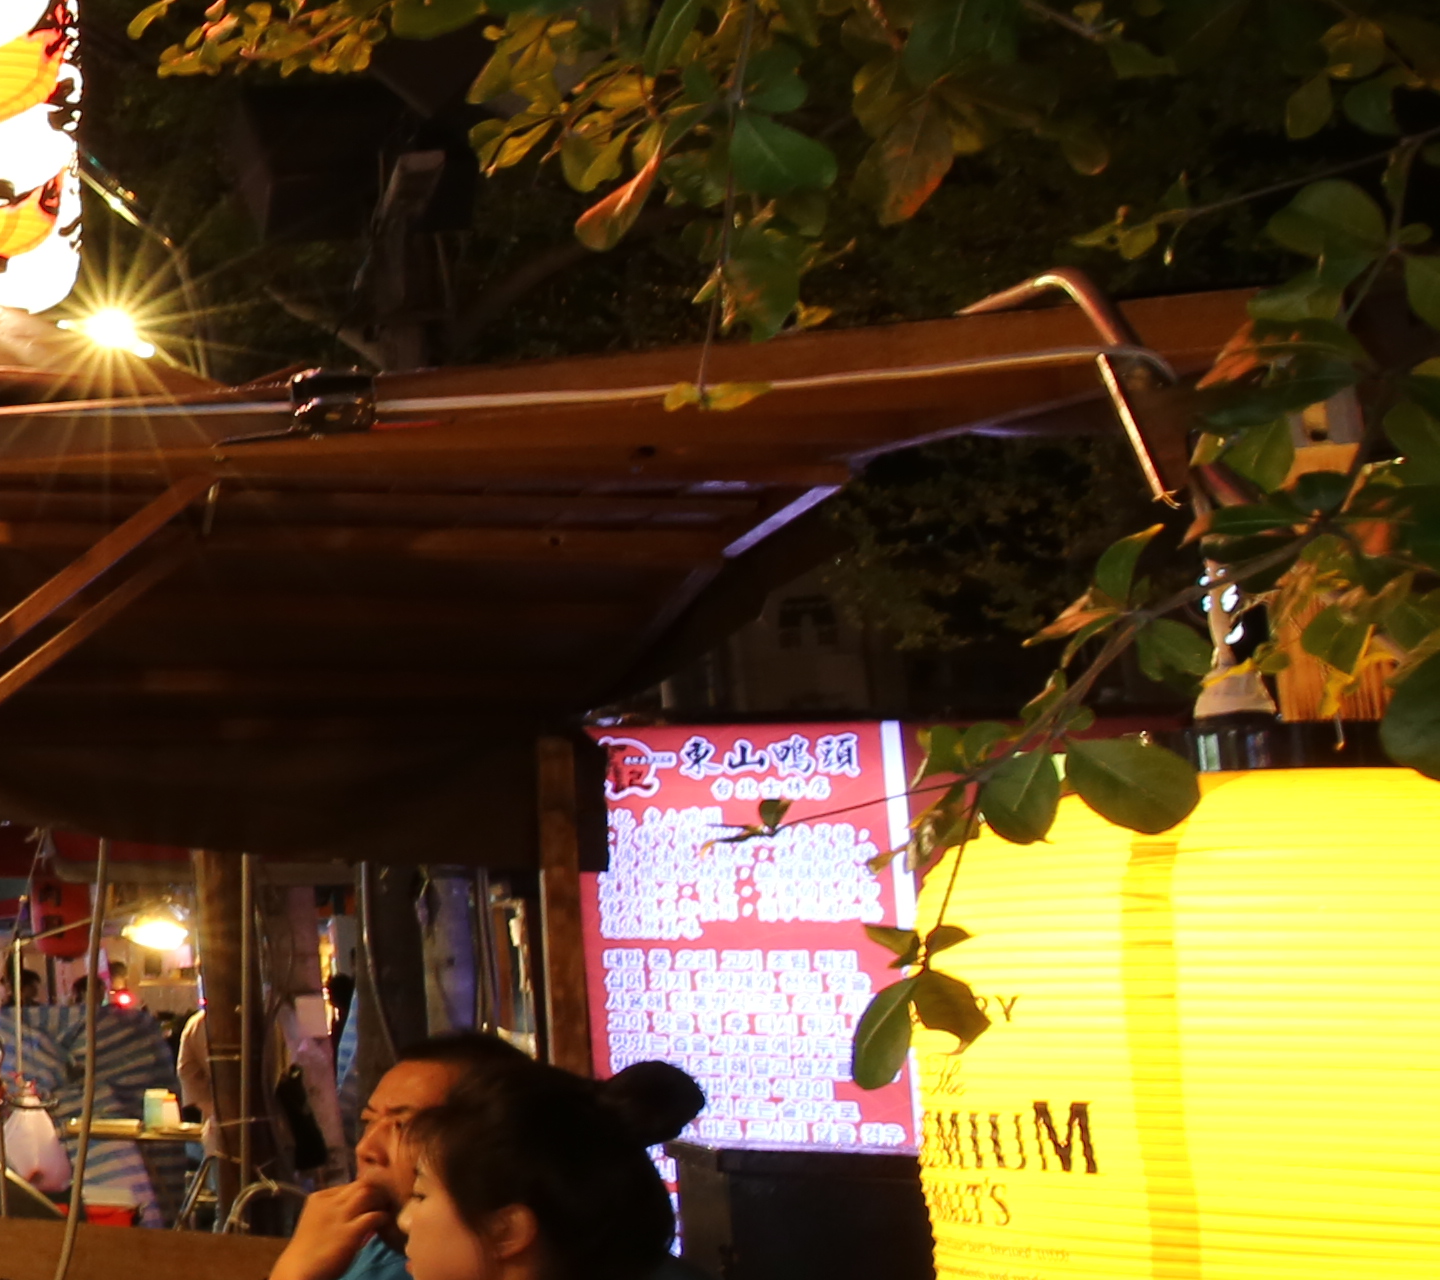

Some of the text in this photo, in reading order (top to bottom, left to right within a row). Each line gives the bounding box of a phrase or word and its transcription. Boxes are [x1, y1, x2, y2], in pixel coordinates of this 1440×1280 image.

[681, 734, 860, 777] 東山鴨頭
[676, 951, 716, 970] 오리
[721, 951, 761, 970] 고기
[650, 972, 690, 993] 가지
[755, 1014, 797, 1034] 다시
[610, 1034, 667, 1056] 맛있는
[918, 1100, 1100, 1174] MIUM
